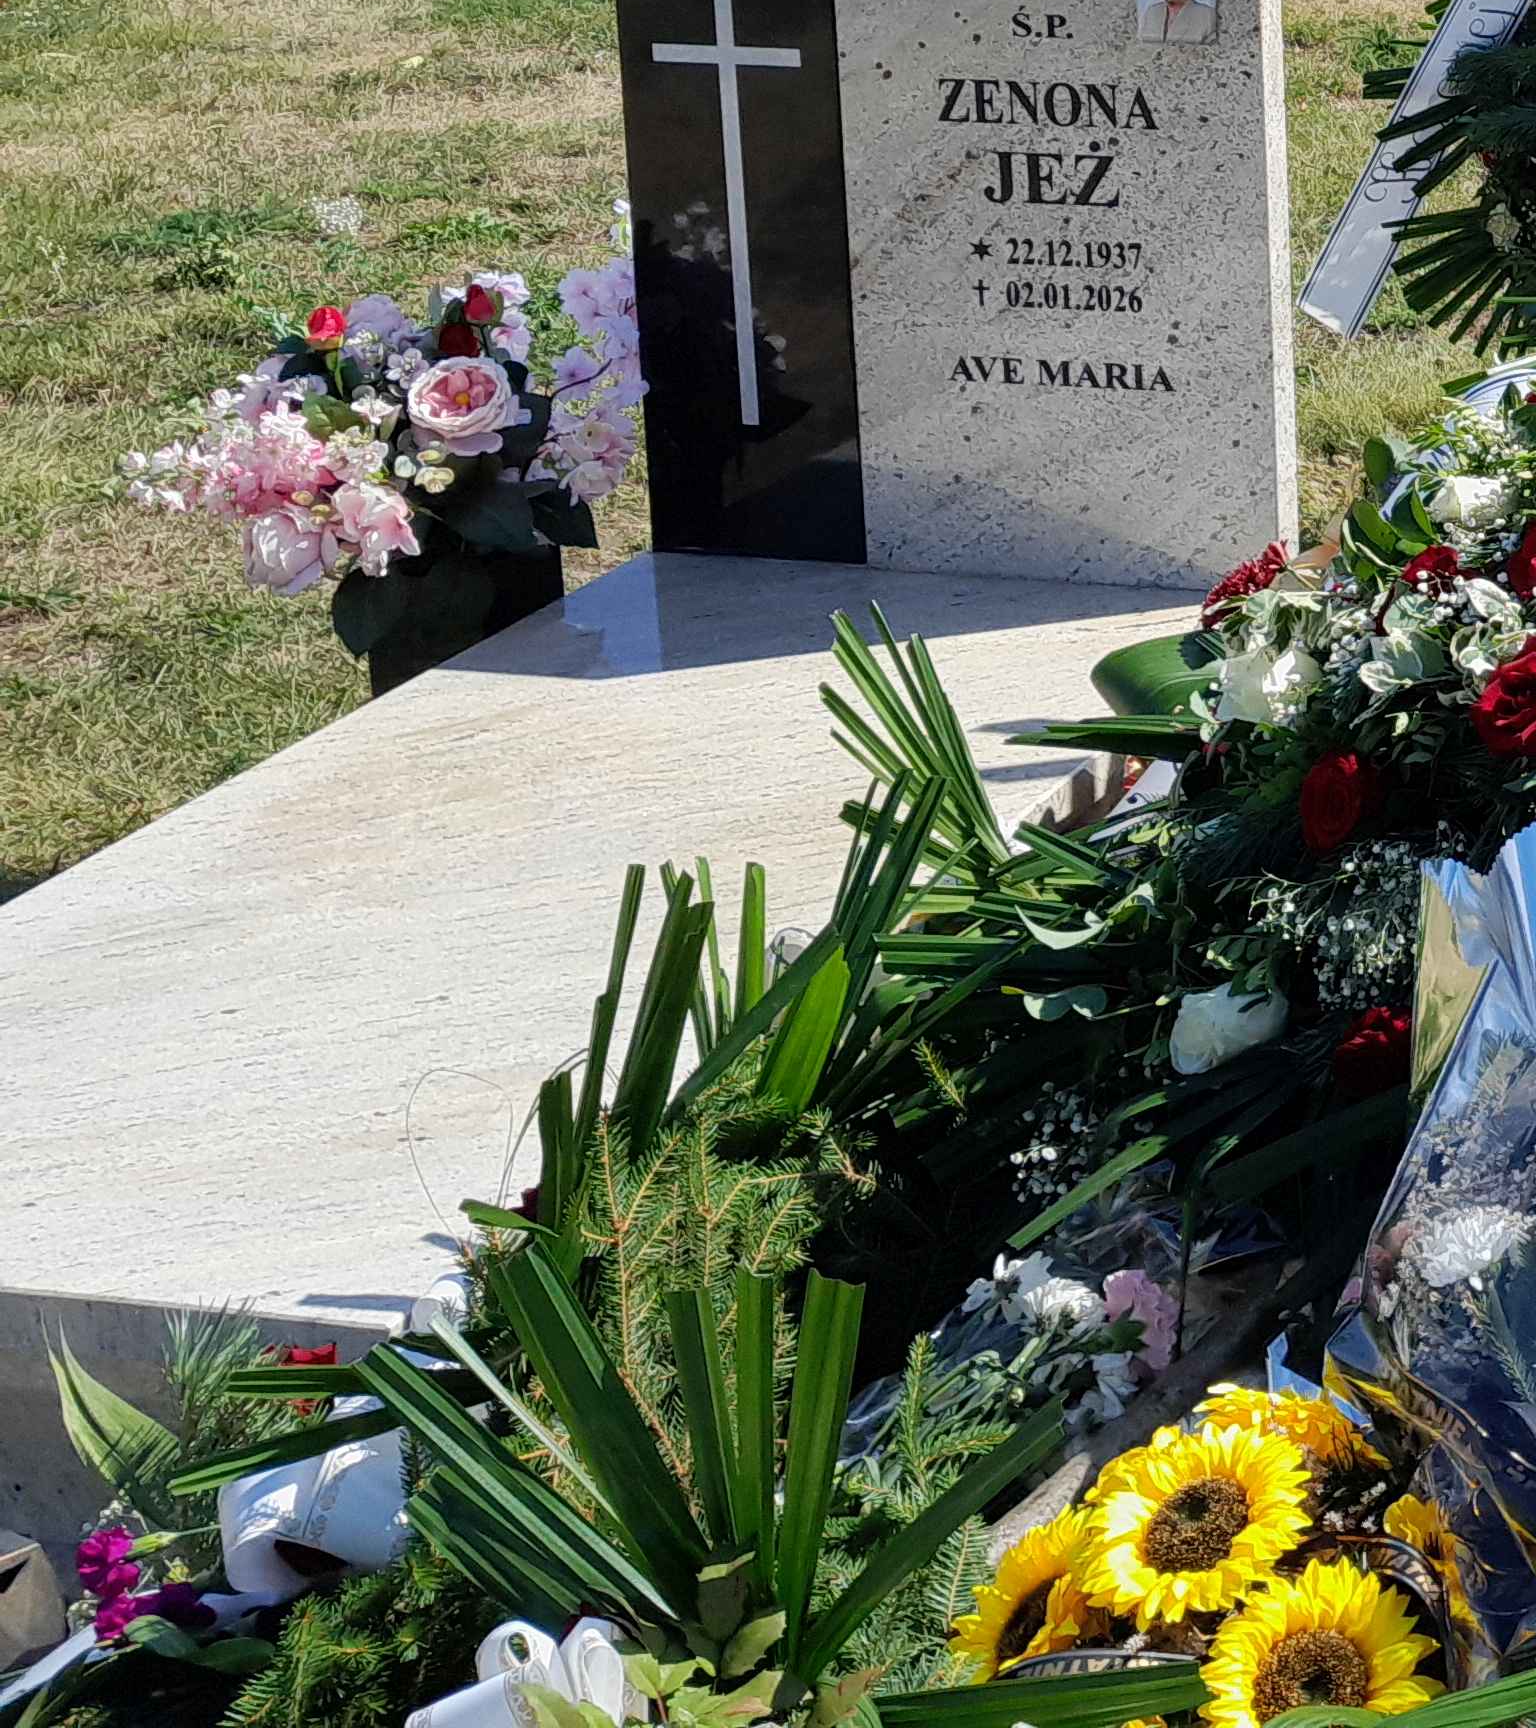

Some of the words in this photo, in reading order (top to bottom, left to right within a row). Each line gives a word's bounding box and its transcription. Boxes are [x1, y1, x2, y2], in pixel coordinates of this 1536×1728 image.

[1012, 5, 1073, 39] Ś.P.
[938, 78, 1159, 130] ZENONA
[984, 140, 1120, 208] JEŻ
[1006, 238, 1142, 270] 22.12.1937
[1006, 281, 1143, 313] 02.01.2026
[950, 355, 1025, 385] AVE
[1036, 358, 1177, 392] MARIA
